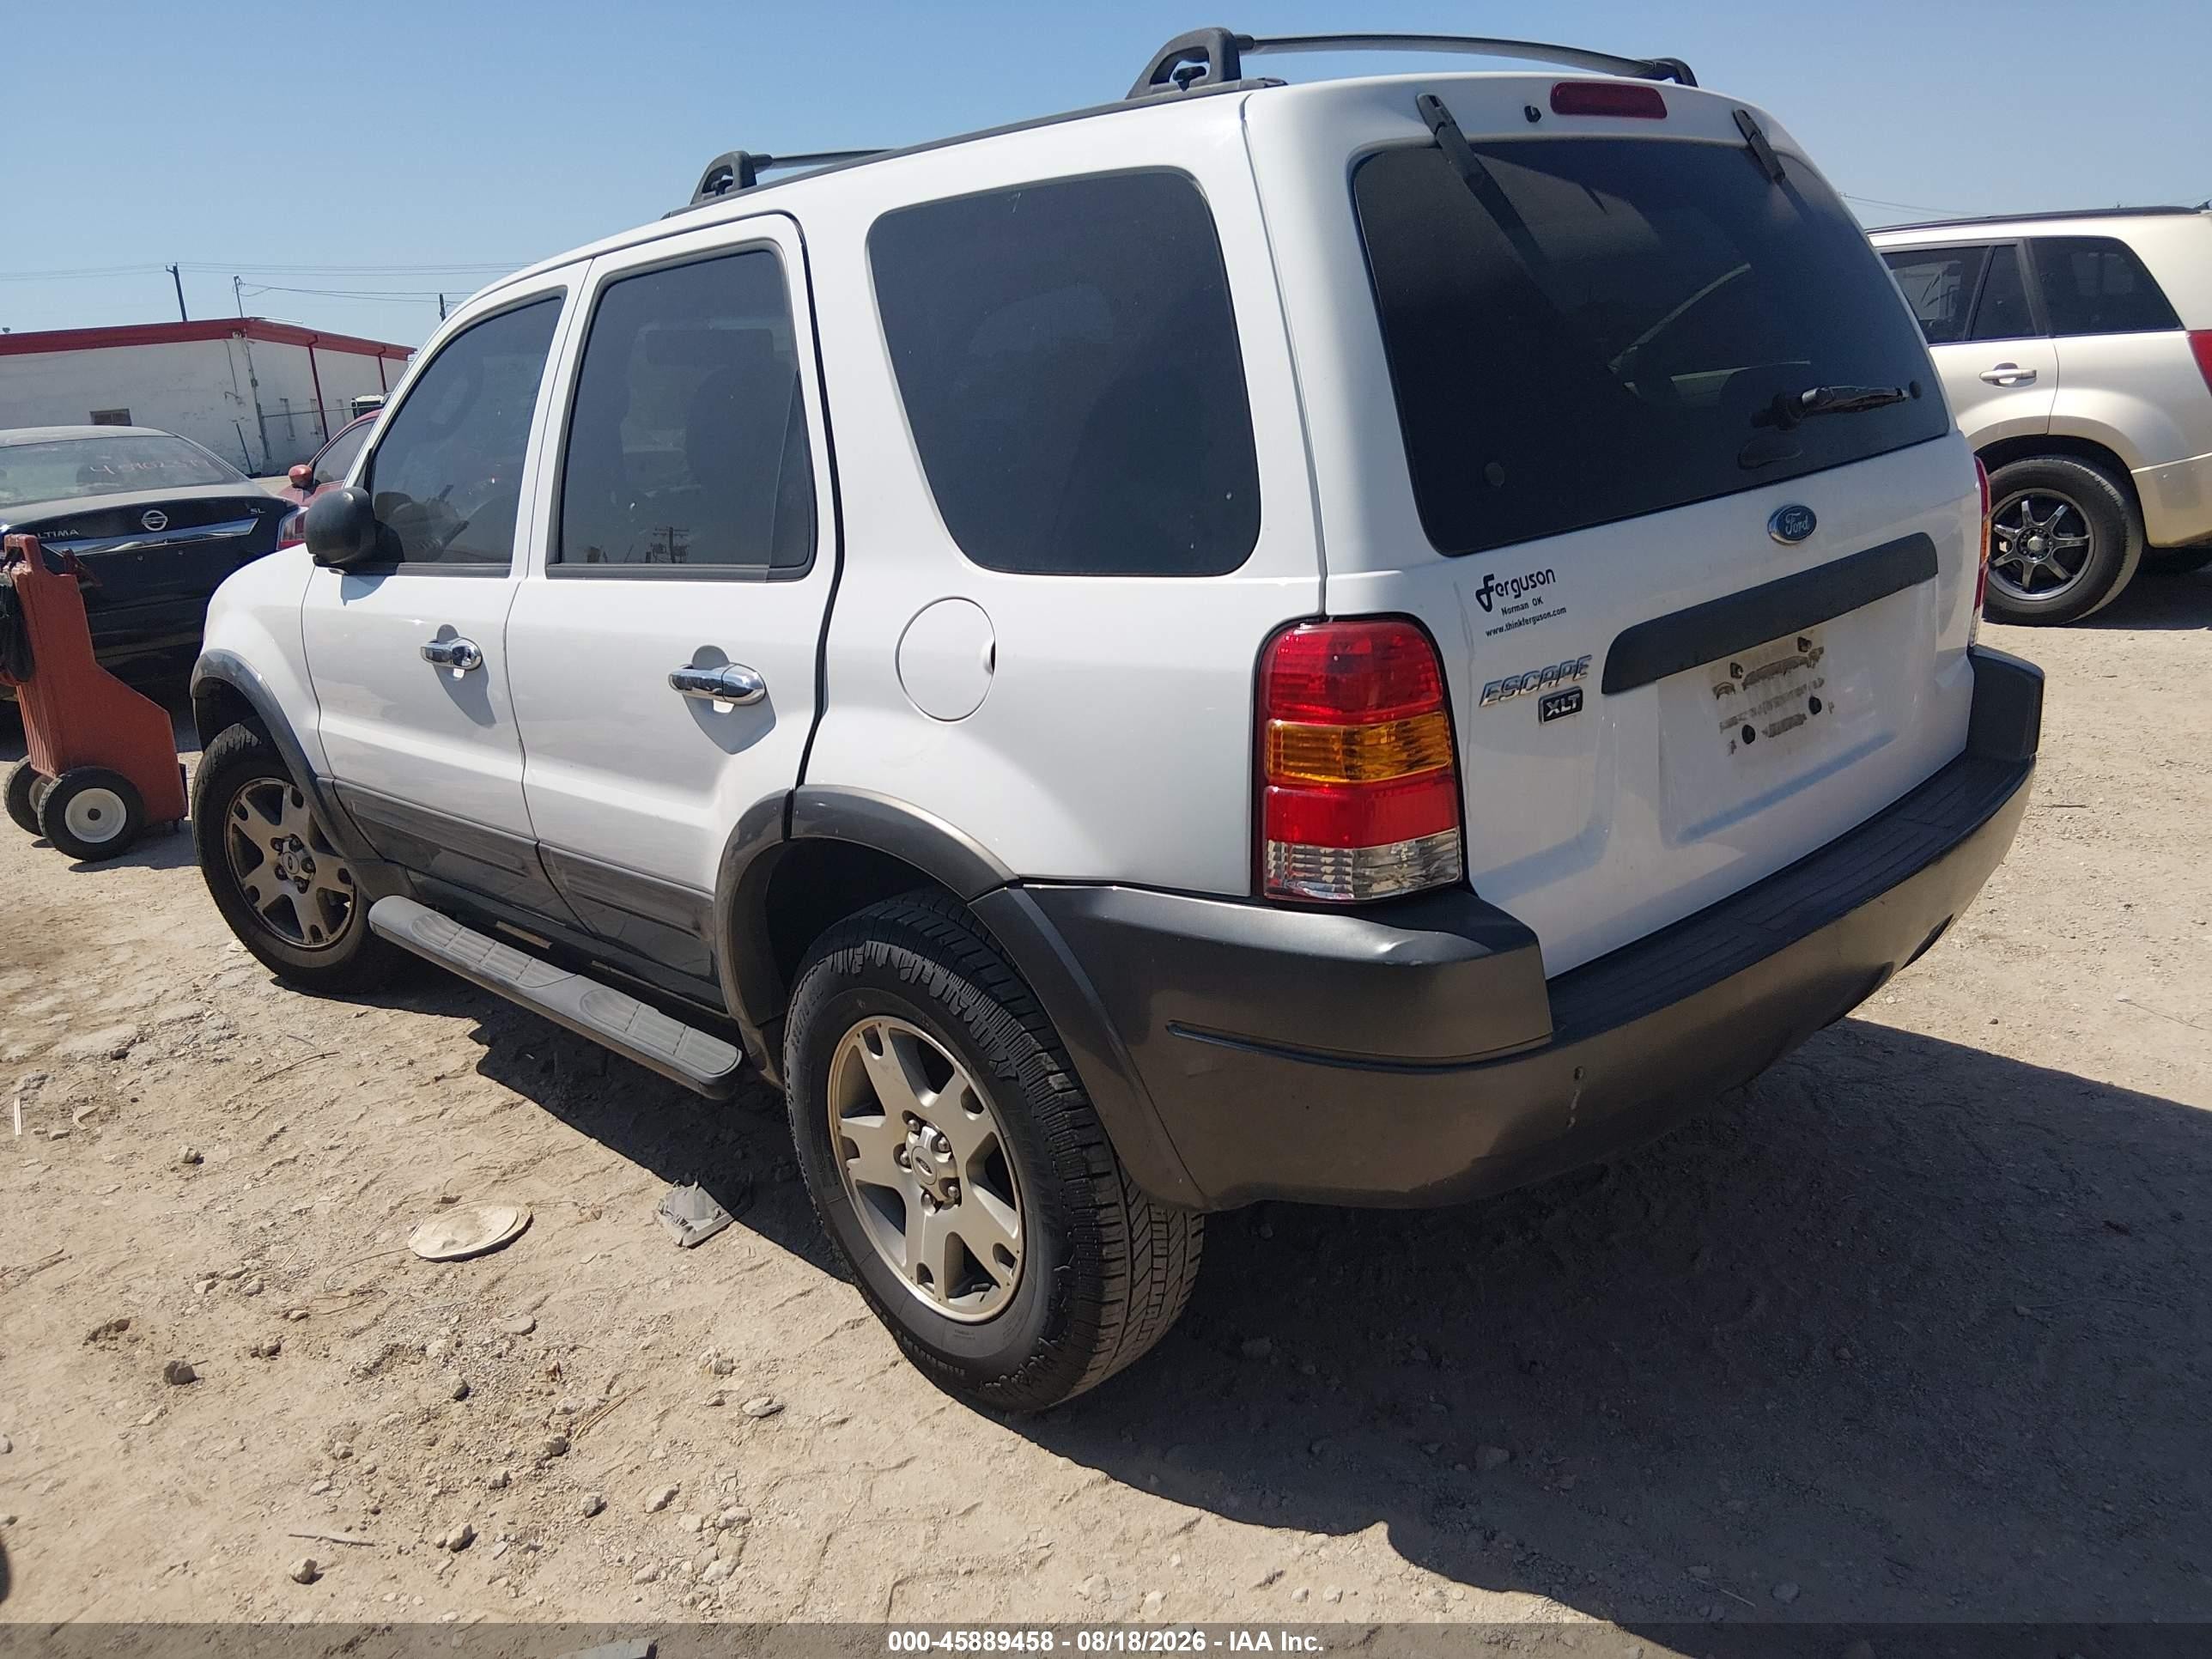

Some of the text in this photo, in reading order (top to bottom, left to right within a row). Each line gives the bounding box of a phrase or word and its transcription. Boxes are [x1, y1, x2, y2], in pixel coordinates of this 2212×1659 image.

[38, 529, 80, 539] LTIMA
[1785, 512, 1808, 536] Ford
[1475, 568, 1556, 612] Ferguson
[1501, 596, 1544, 617] Norman OK
[1486, 606, 1567, 637] www.thinkferguson.com
[1479, 653, 1593, 708] ESCAPE
[1546, 693, 1580, 717] XLT
